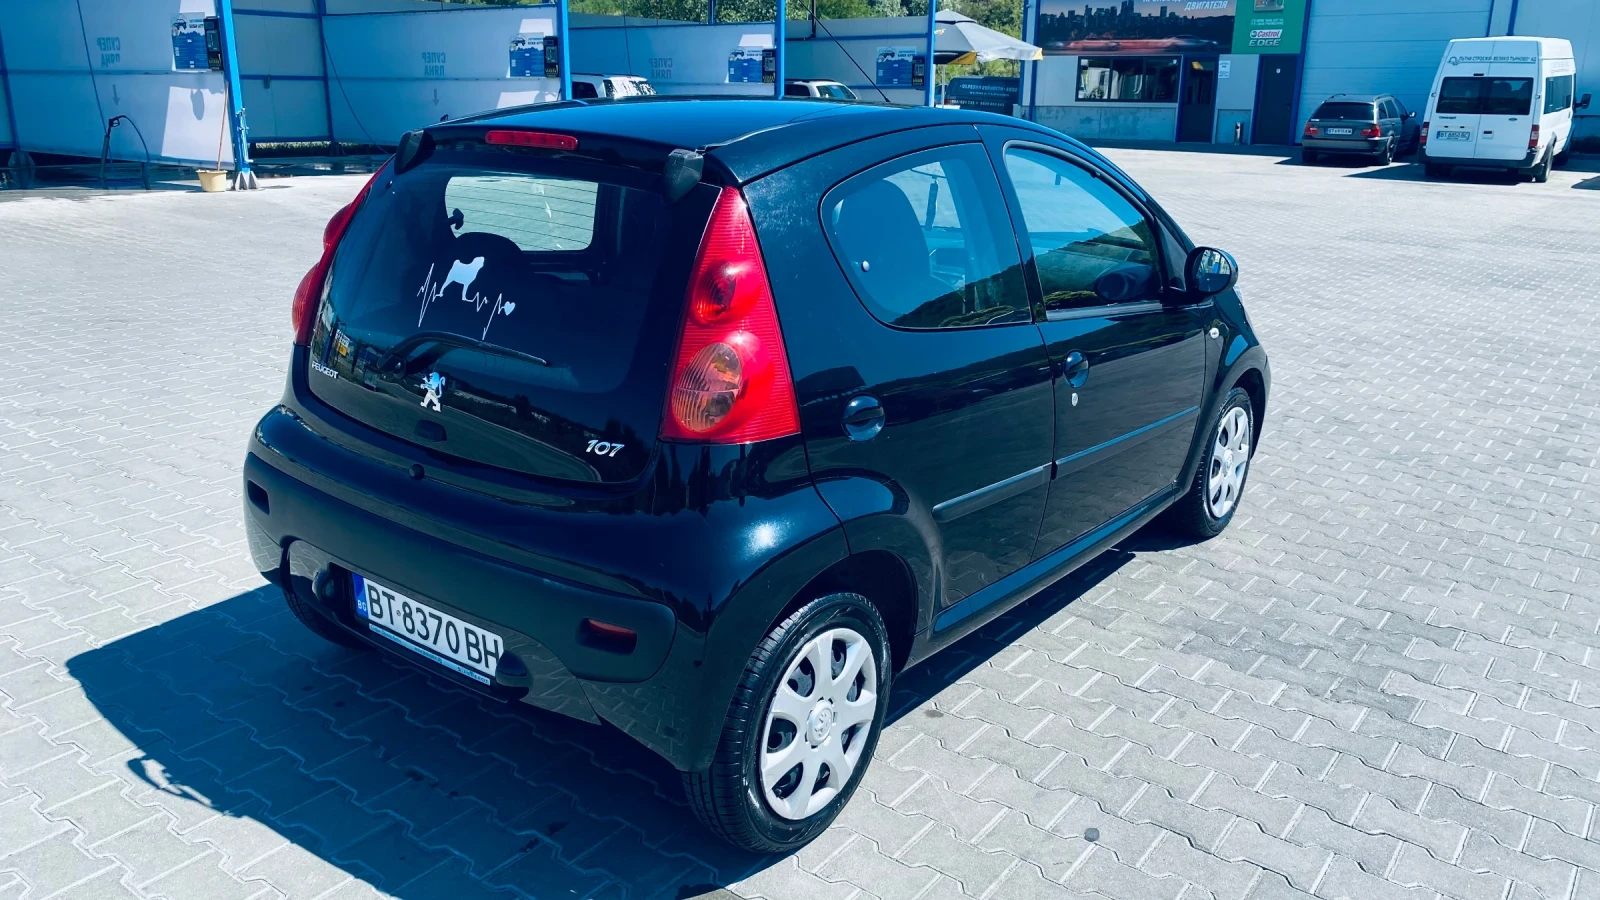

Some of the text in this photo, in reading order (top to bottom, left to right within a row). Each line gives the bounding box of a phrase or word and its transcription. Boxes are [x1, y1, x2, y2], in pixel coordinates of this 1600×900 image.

[1184, 1, 1228, 11] ДВИГАТЕЛЯ
[1257, 30, 1280, 38] Castrol
[311, 360, 339, 379] PEUGEOT
[585, 439, 625, 457] 107
[357, 599, 367, 611] BG
[367, 583, 395, 626] BT
[401, 601, 460, 655] 8370
[464, 626, 500, 669] BH
